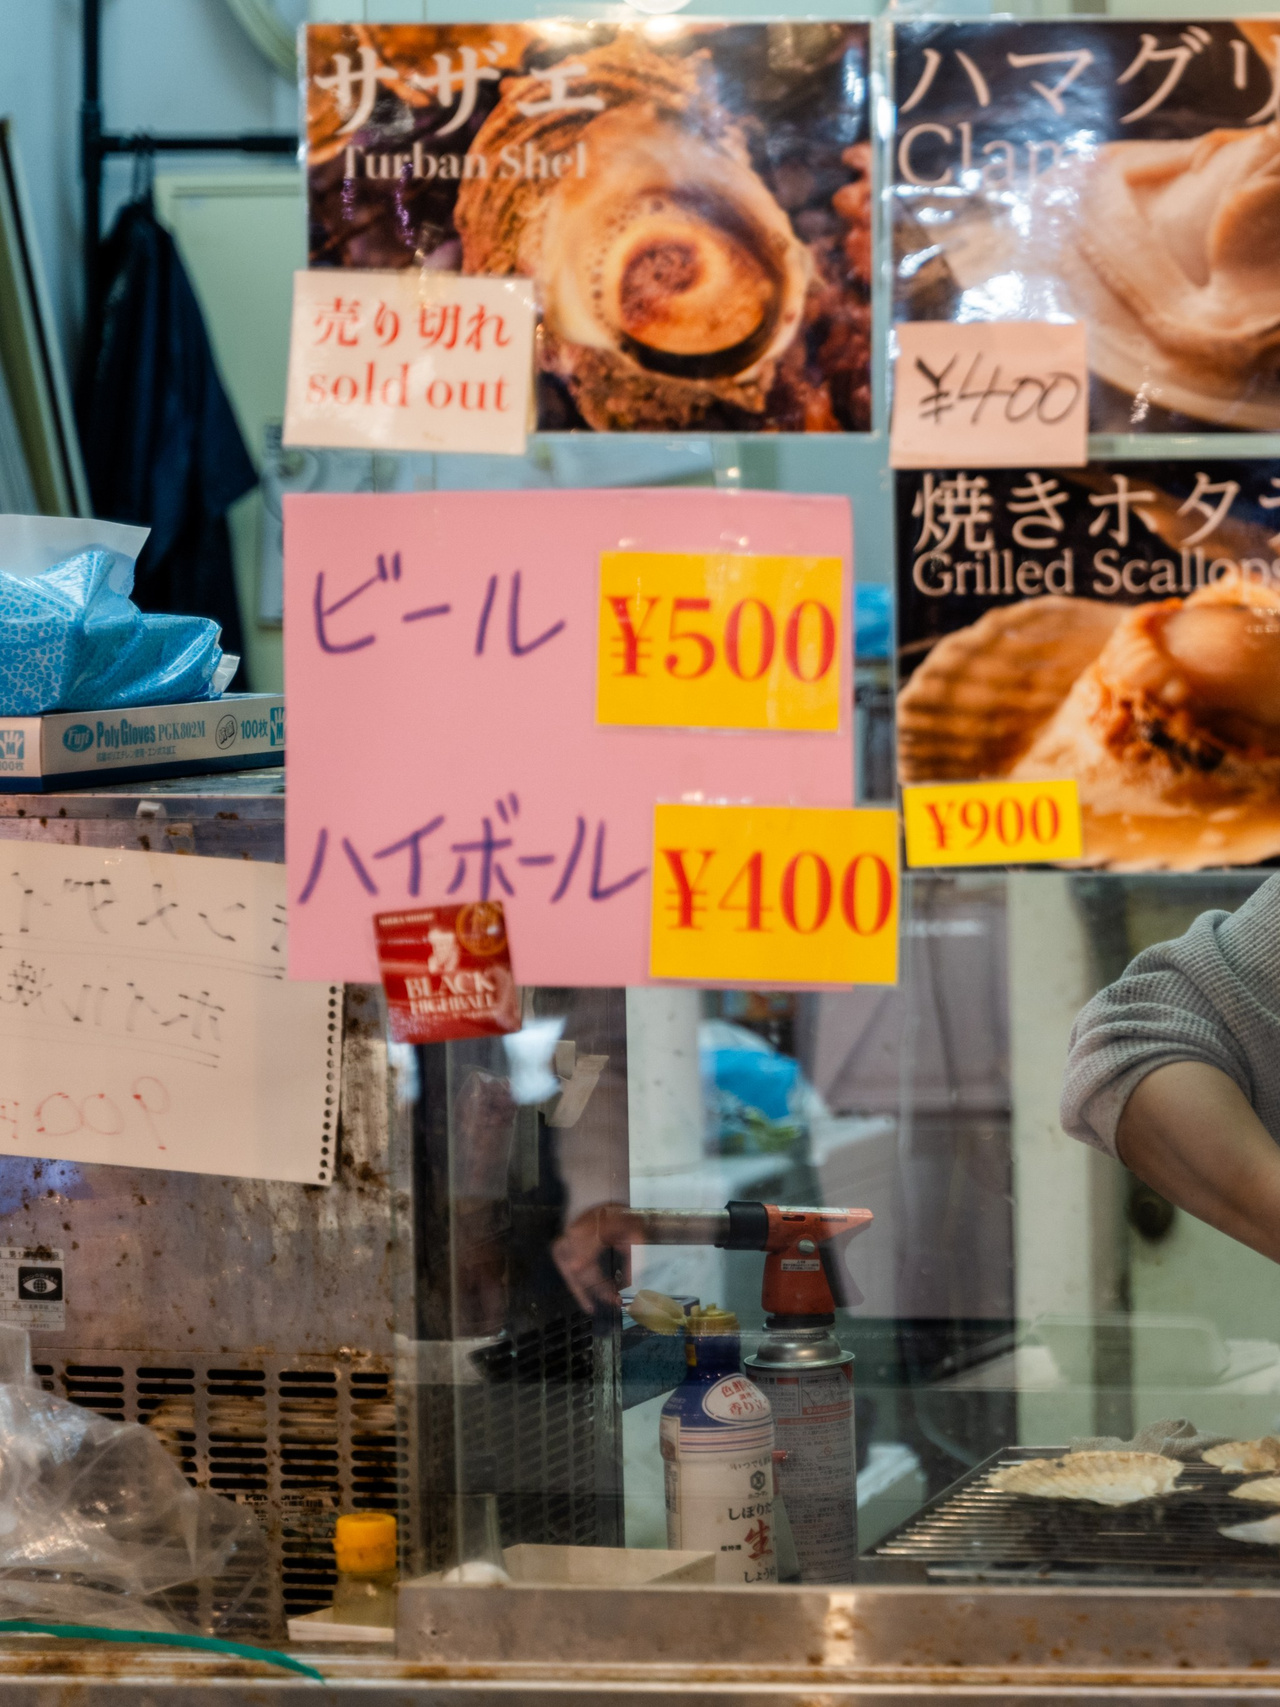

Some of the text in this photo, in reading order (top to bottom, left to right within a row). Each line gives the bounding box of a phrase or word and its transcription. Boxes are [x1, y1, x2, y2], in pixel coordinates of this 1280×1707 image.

[312, 42, 606, 138] サザエ
[340, 141, 488, 180] Turban
[312, 297, 512, 351] 売り切れ
[306, 364, 510, 412] sold out
[914, 352, 1080, 425] ¥400
[912, 551, 1074, 596] Grilled
[314, 551, 566, 656] ビール
[606, 595, 838, 683] ¥500
[67, 727, 91, 749] Fuji
[241, 719, 268, 739] 100枚
[298, 793, 648, 904] ハイボール
[925, 795, 1061, 850] ¥900
[661, 847, 894, 936] ¥400
[404, 972, 496, 999] BLACK
[744, 1520, 773, 1560] 生
